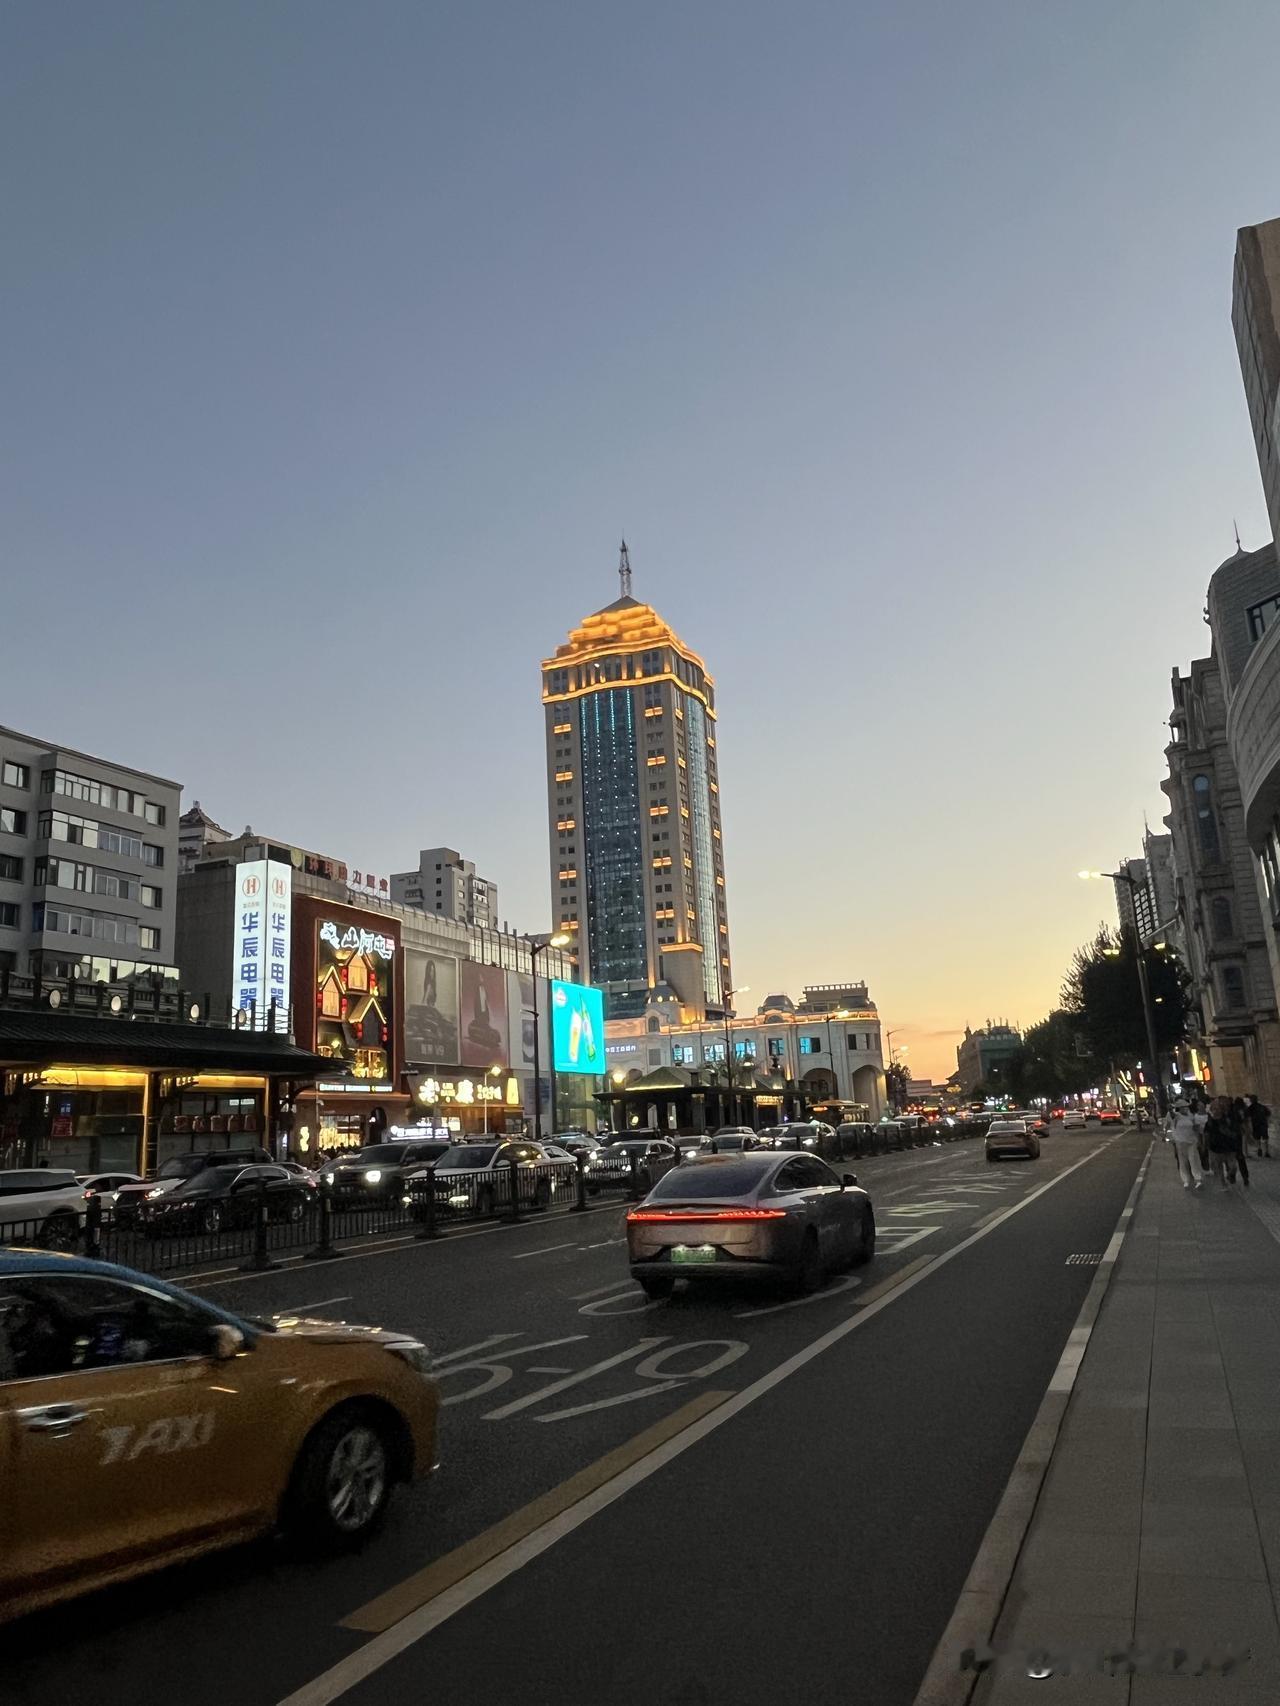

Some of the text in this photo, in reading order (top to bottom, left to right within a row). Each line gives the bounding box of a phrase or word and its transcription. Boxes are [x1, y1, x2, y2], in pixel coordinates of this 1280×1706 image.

[239, 911, 259, 1009] 华辰电器
[271, 912, 286, 1009] 华辰电器
[98, 1411, 217, 1465] TAXI
